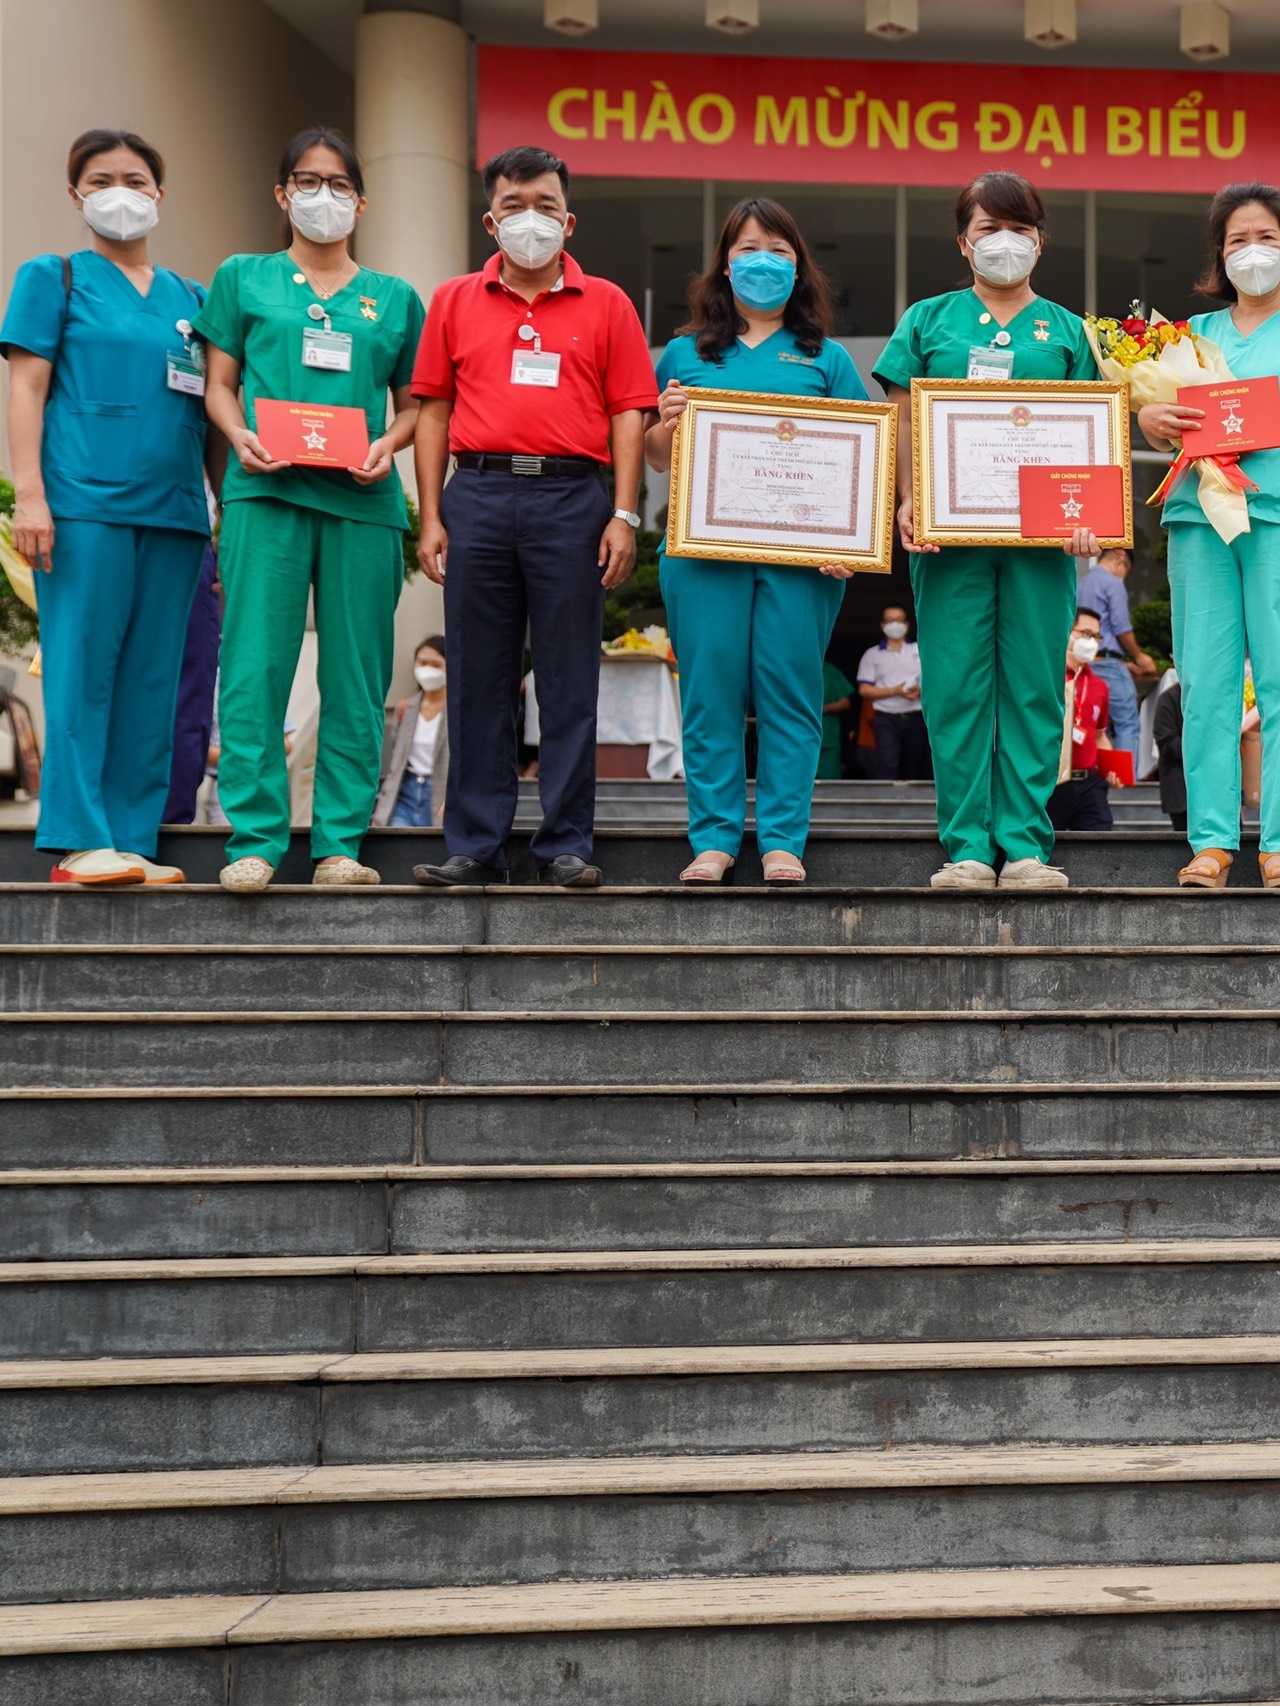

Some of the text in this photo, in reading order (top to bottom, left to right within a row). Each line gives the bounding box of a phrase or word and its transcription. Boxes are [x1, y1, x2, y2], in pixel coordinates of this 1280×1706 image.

[547, 80, 1246, 168] CHÀO MỪNG ĐẠI BIỂU
